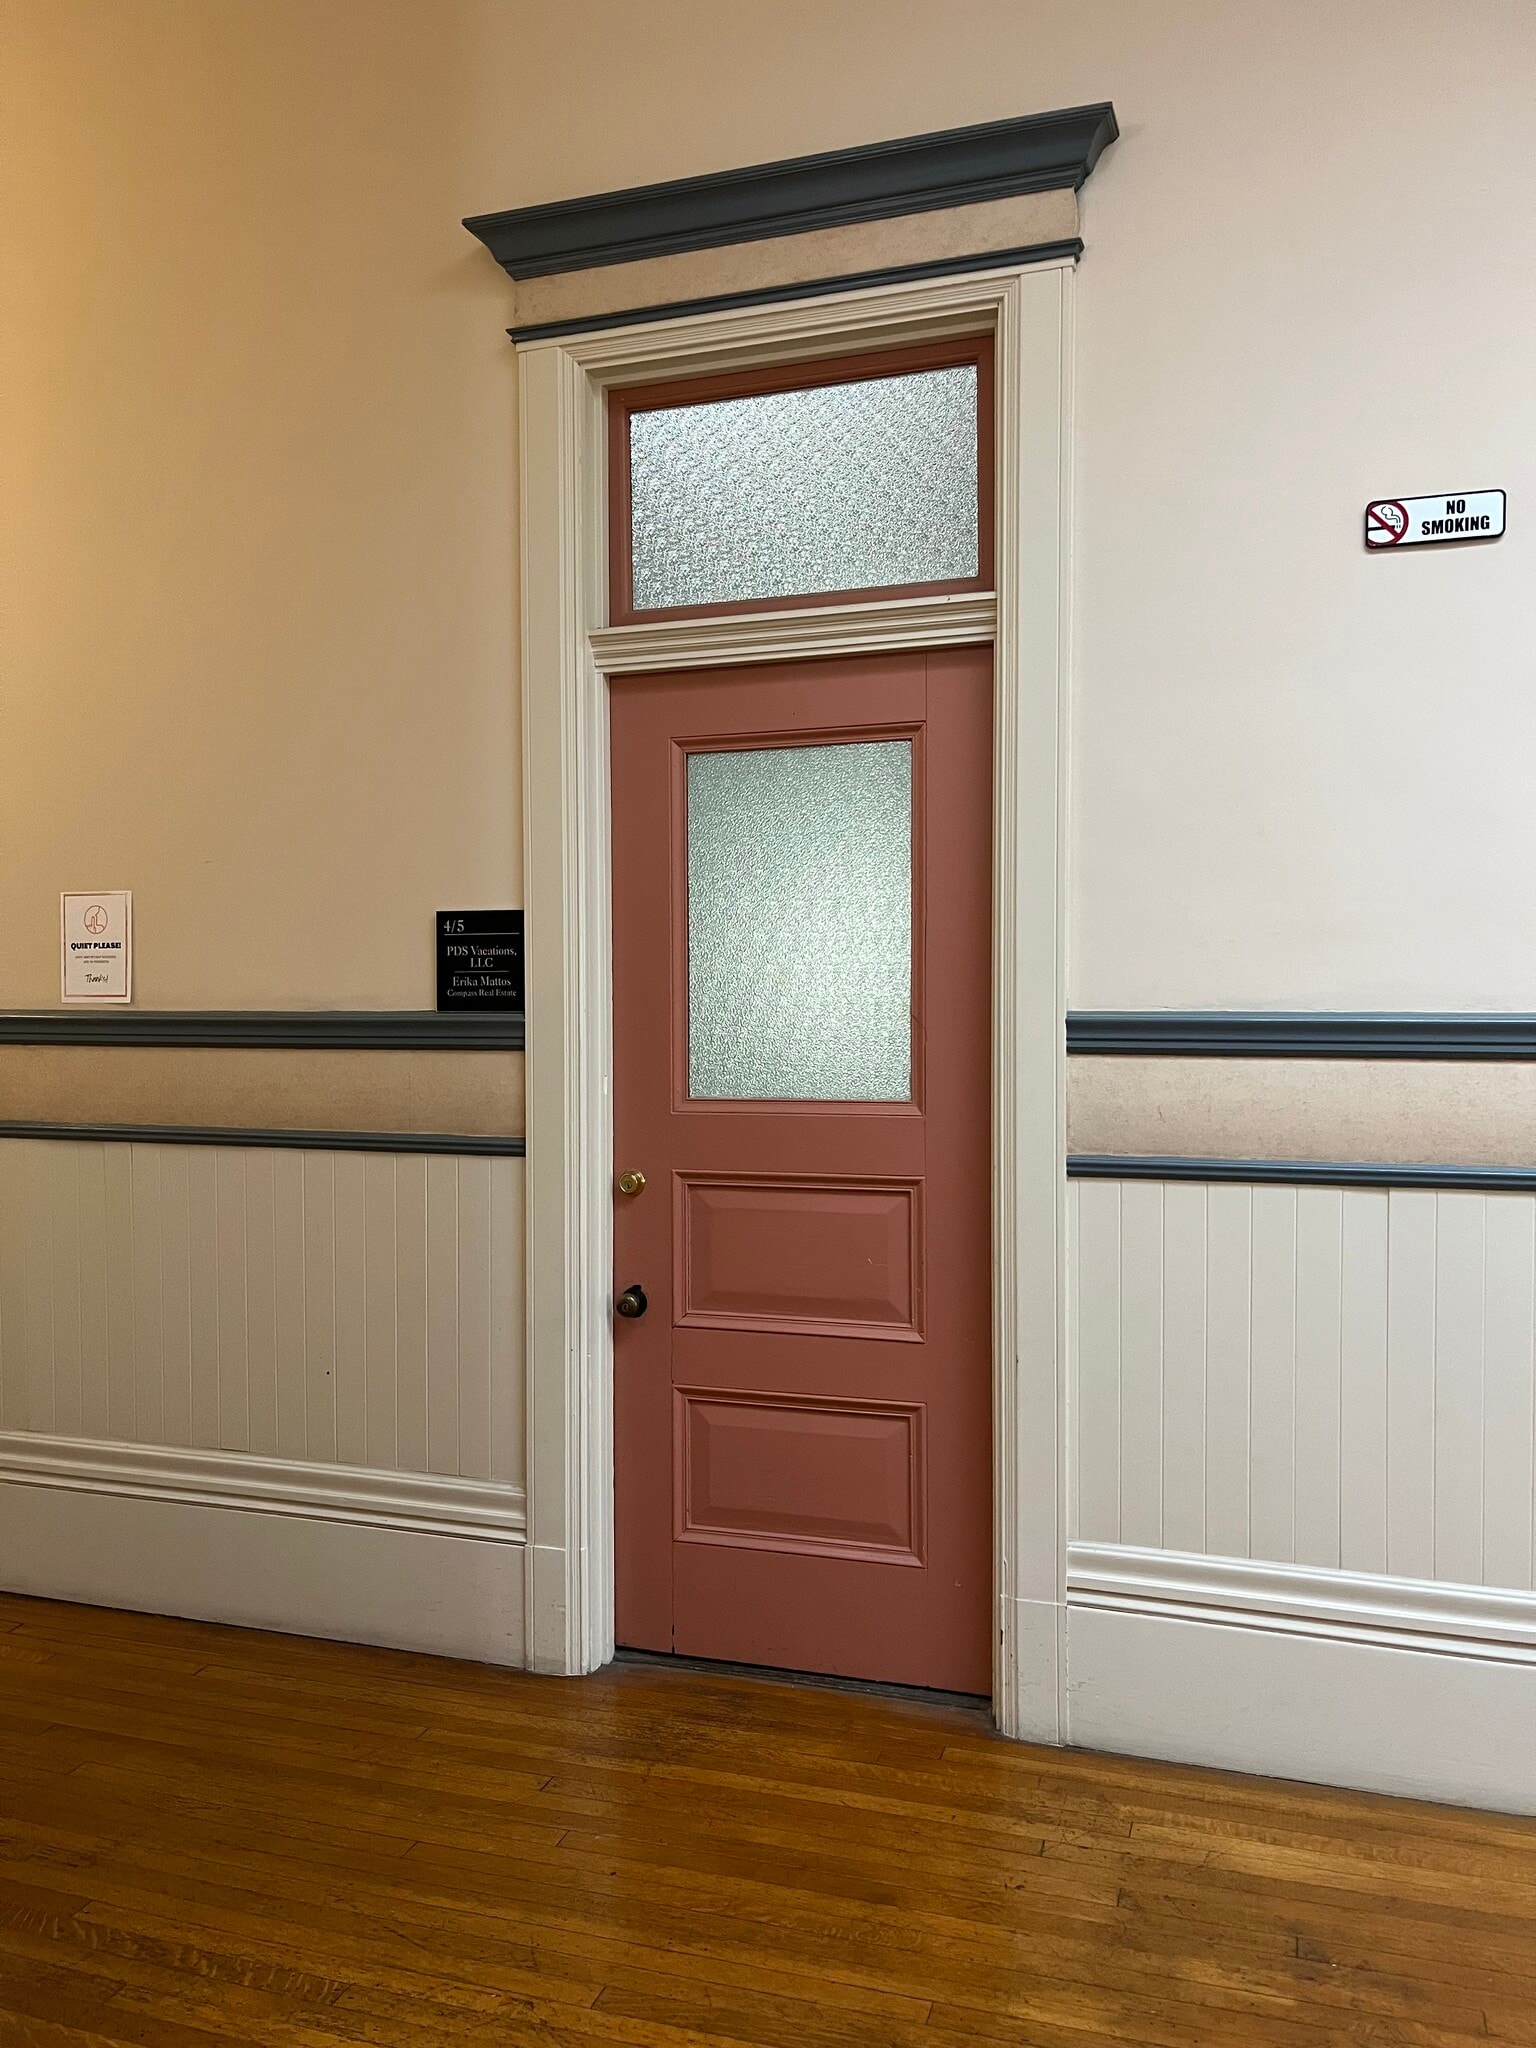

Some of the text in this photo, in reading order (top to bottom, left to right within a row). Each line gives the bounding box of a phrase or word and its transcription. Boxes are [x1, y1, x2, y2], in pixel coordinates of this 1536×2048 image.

[1446, 499, 1466, 515] NO
[1421, 515, 1490, 535] SMOKING
[443, 919, 465, 933] 4/5
[70, 942, 93, 951] QUIET
[446, 945, 517, 957] PDS Vacations,
[470, 957, 494, 968] LLC
[452, 975, 512, 987] Erika Mattos
[446, 988, 517, 998] Compass Real Estate
